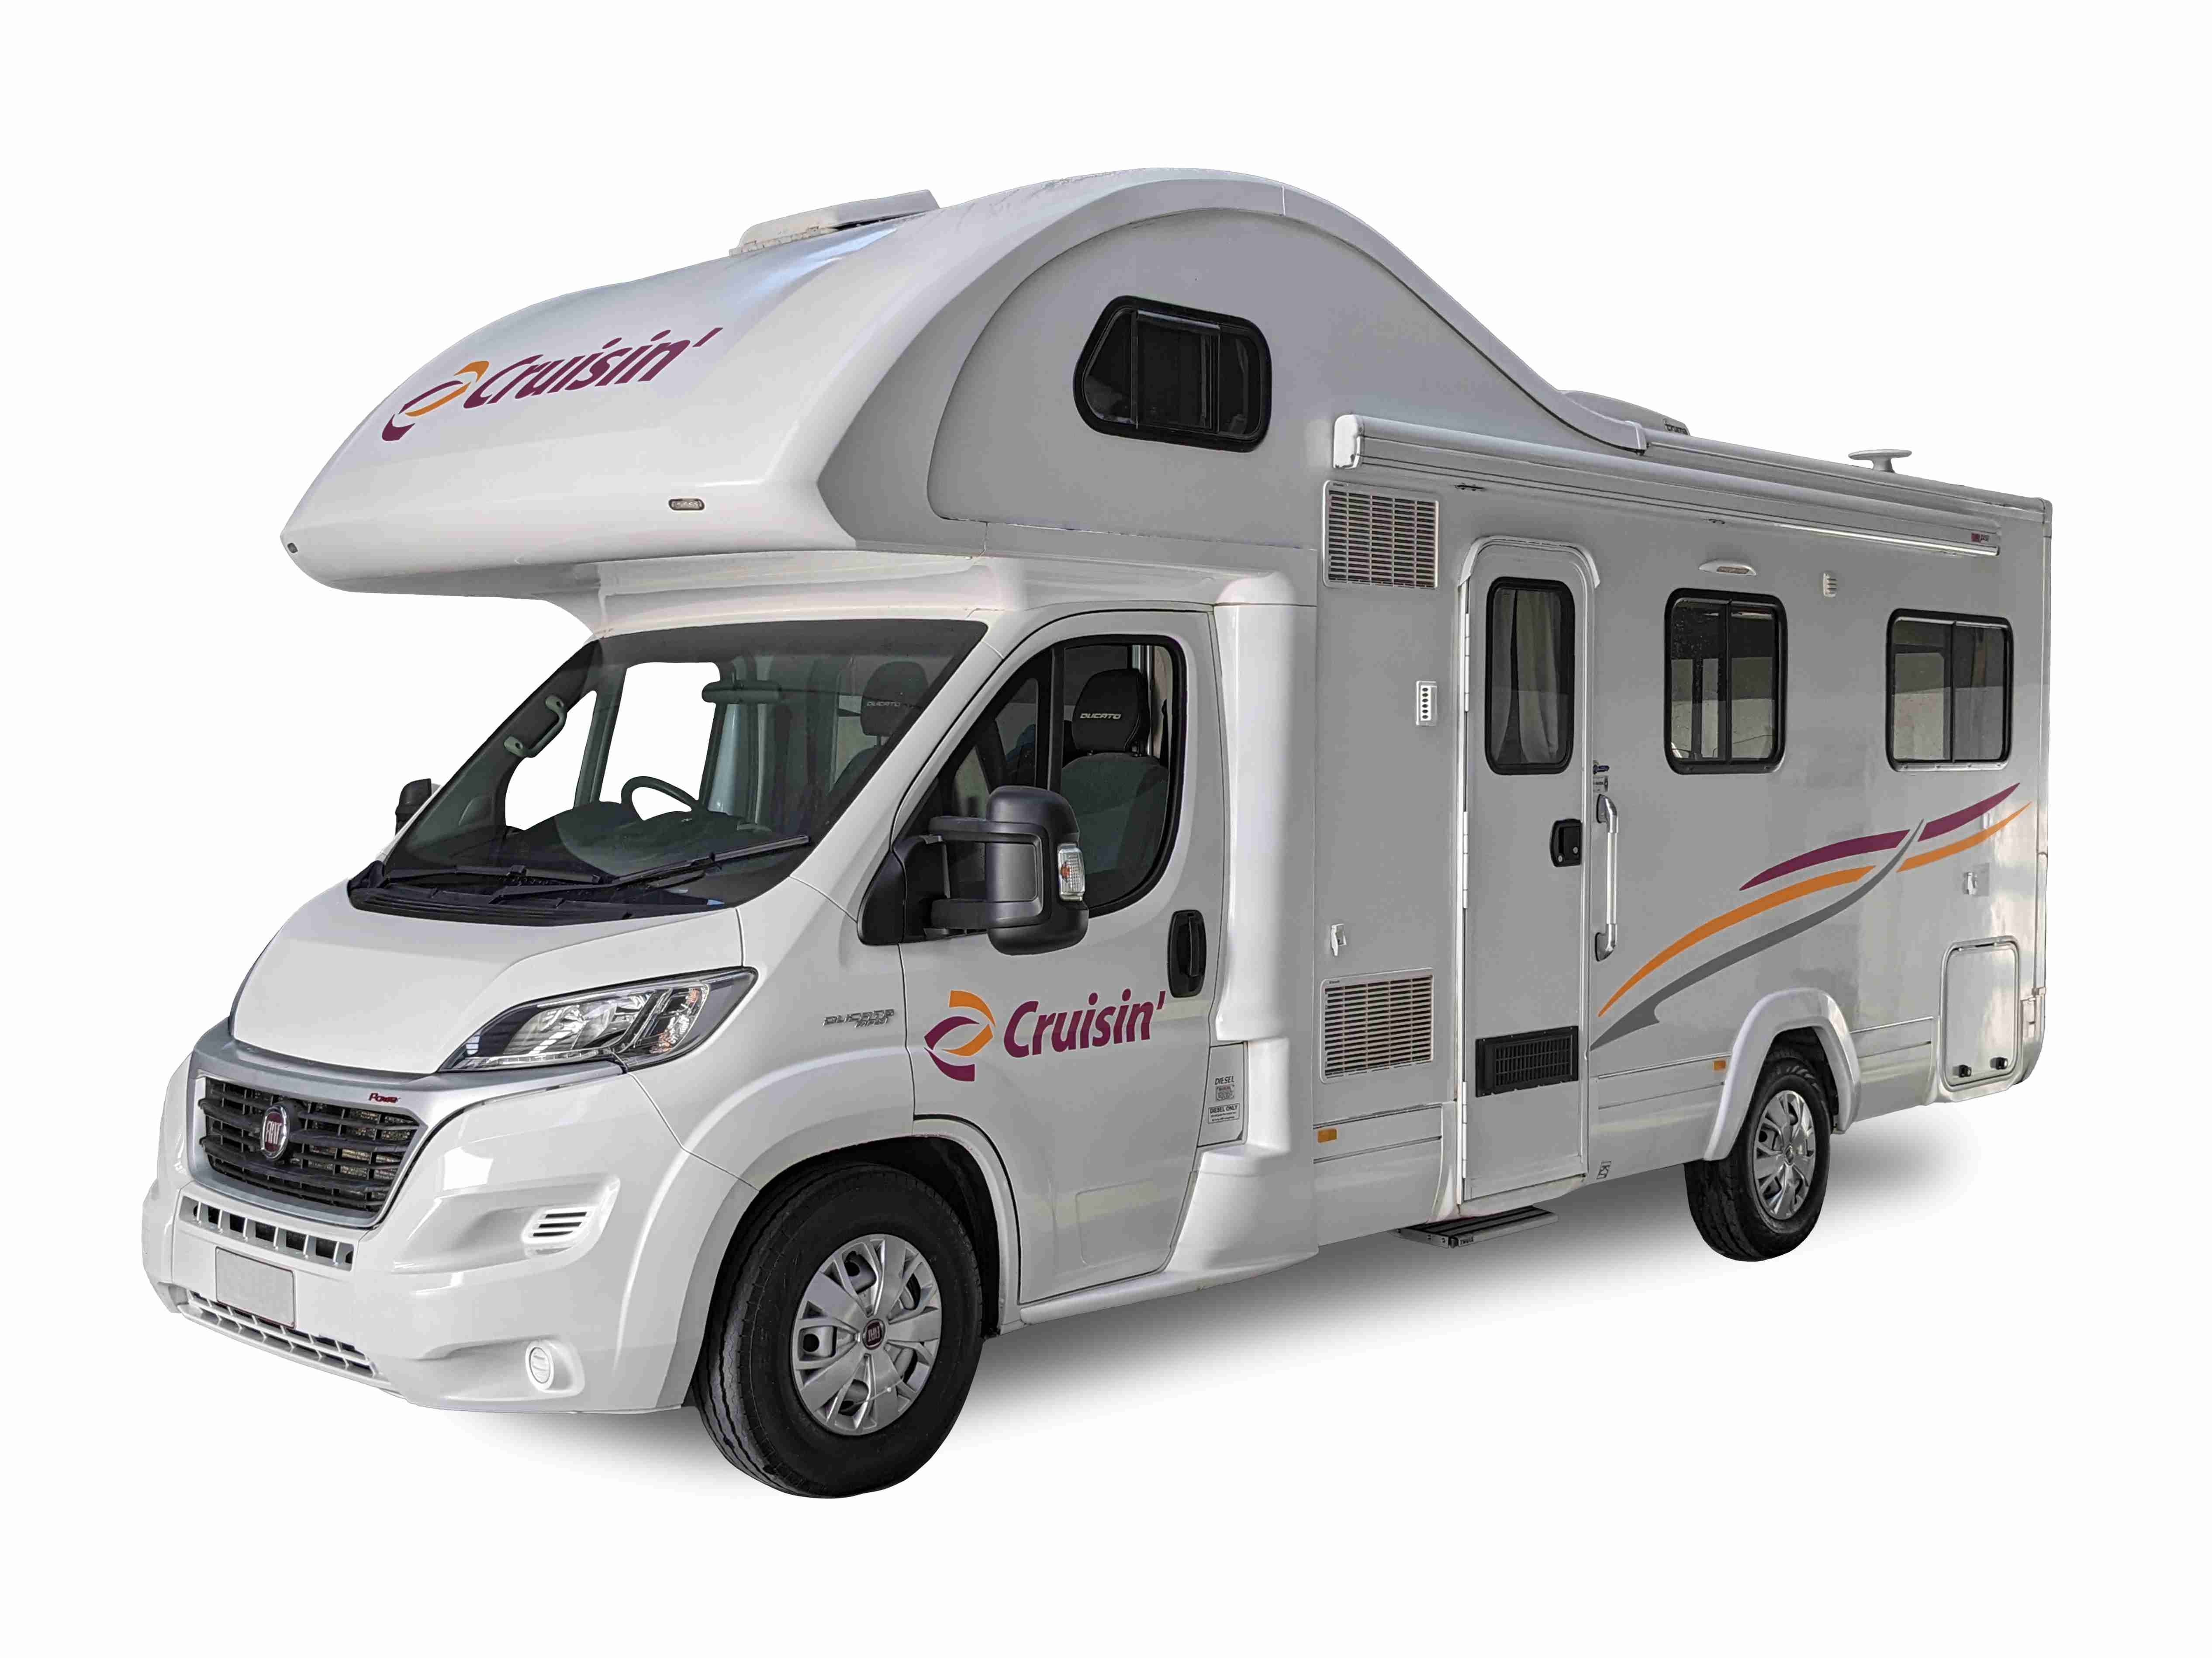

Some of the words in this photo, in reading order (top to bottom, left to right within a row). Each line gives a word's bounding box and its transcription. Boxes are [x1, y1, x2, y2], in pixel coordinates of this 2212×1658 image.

[463, 327, 723, 409] Cruisin'
[1003, 988, 1166, 1058] Cruisin'
[1215, 1075, 1234, 1085] DIESEL
[266, 1120, 282, 1145] FIAT
